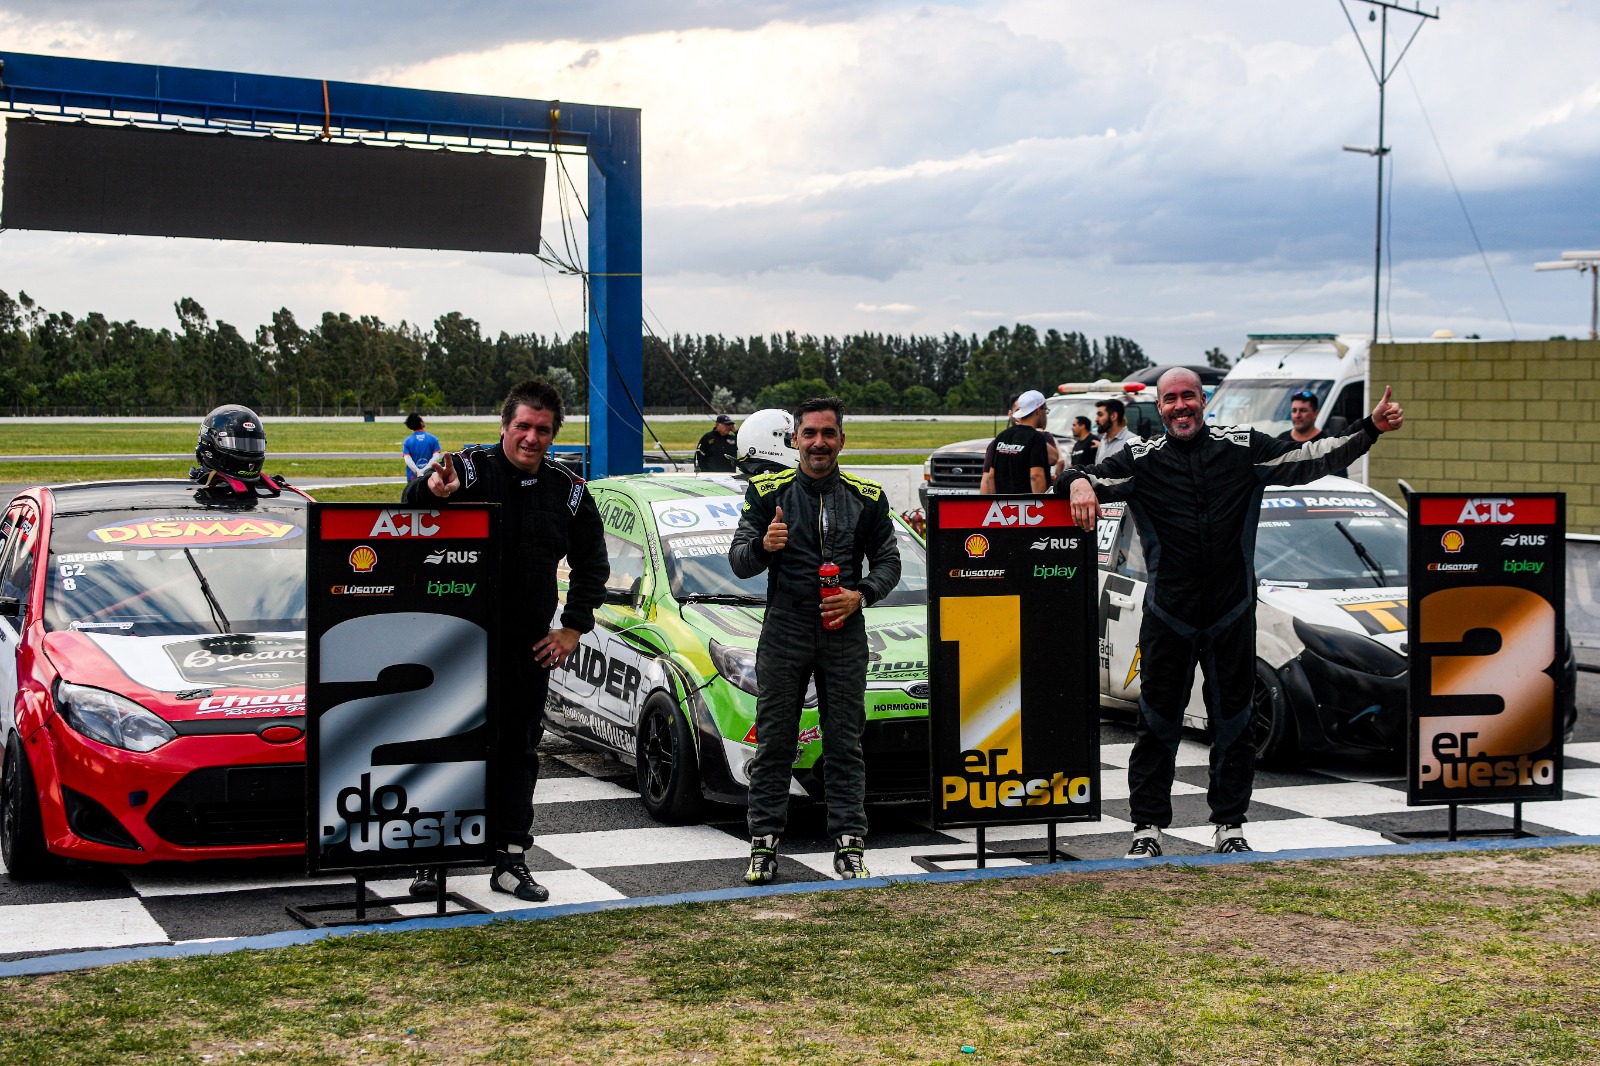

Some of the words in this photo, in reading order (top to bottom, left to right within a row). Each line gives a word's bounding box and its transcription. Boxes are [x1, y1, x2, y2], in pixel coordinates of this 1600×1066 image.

[982, 500, 1044, 526] ACTC
[1303, 497, 1377, 507] RACING
[1457, 499, 1515, 523] ACTC
[369, 509, 440, 536] ACTC
[608, 505, 636, 534] RUTA
[94, 521, 295, 543] DISMAY
[1050, 538, 1078, 549] RUS
[1519, 535, 1545, 545] RUS
[447, 551, 478, 563] RUS
[59, 564, 86, 577] C2
[63, 578, 77, 591] 8
[940, 595, 1022, 775] 1
[1419, 586, 1556, 762] 3
[224, 705, 281, 717] Racing
[319, 612, 488, 830] 2
[1419, 757, 1554, 789] Puesto
[942, 772, 1091, 809] Puesto
